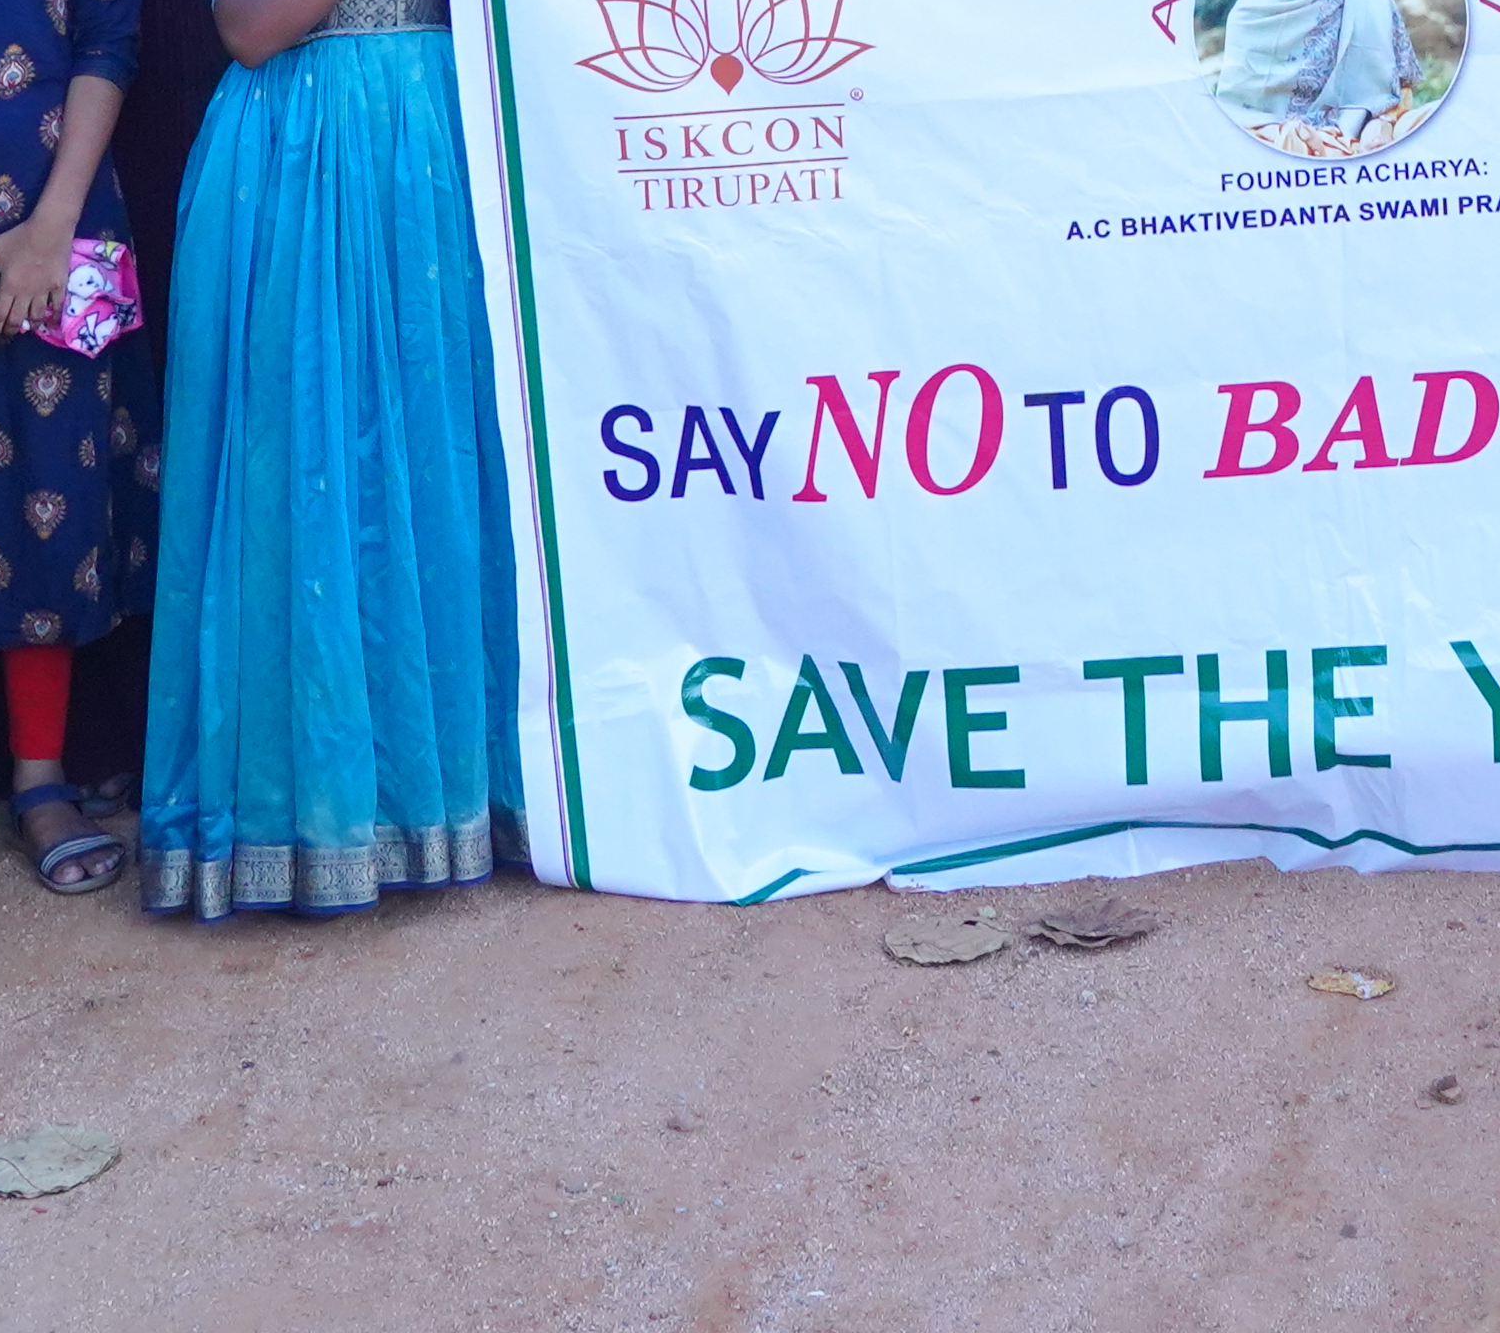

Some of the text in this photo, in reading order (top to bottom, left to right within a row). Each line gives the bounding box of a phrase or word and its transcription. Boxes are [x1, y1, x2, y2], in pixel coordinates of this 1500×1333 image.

[614, 115, 845, 161] ISKCON
[634, 167, 844, 211] TIRUPATI
[1221, 158, 1489, 192] FOUNDER ACHARYA:
[1066, 219, 1111, 241] A.C
[1121, 202, 1351, 238] BHAKTIVEDANTA
[1360, 196, 1449, 222] SWAMI
[601, 404, 781, 502] SAY
[792, 363, 1004, 502] NO
[1024, 385, 1159, 490] TO
[1203, 370, 1499, 479] BAD
[681, 654, 1026, 792] SAVE
[1083, 645, 1391, 785] THE
